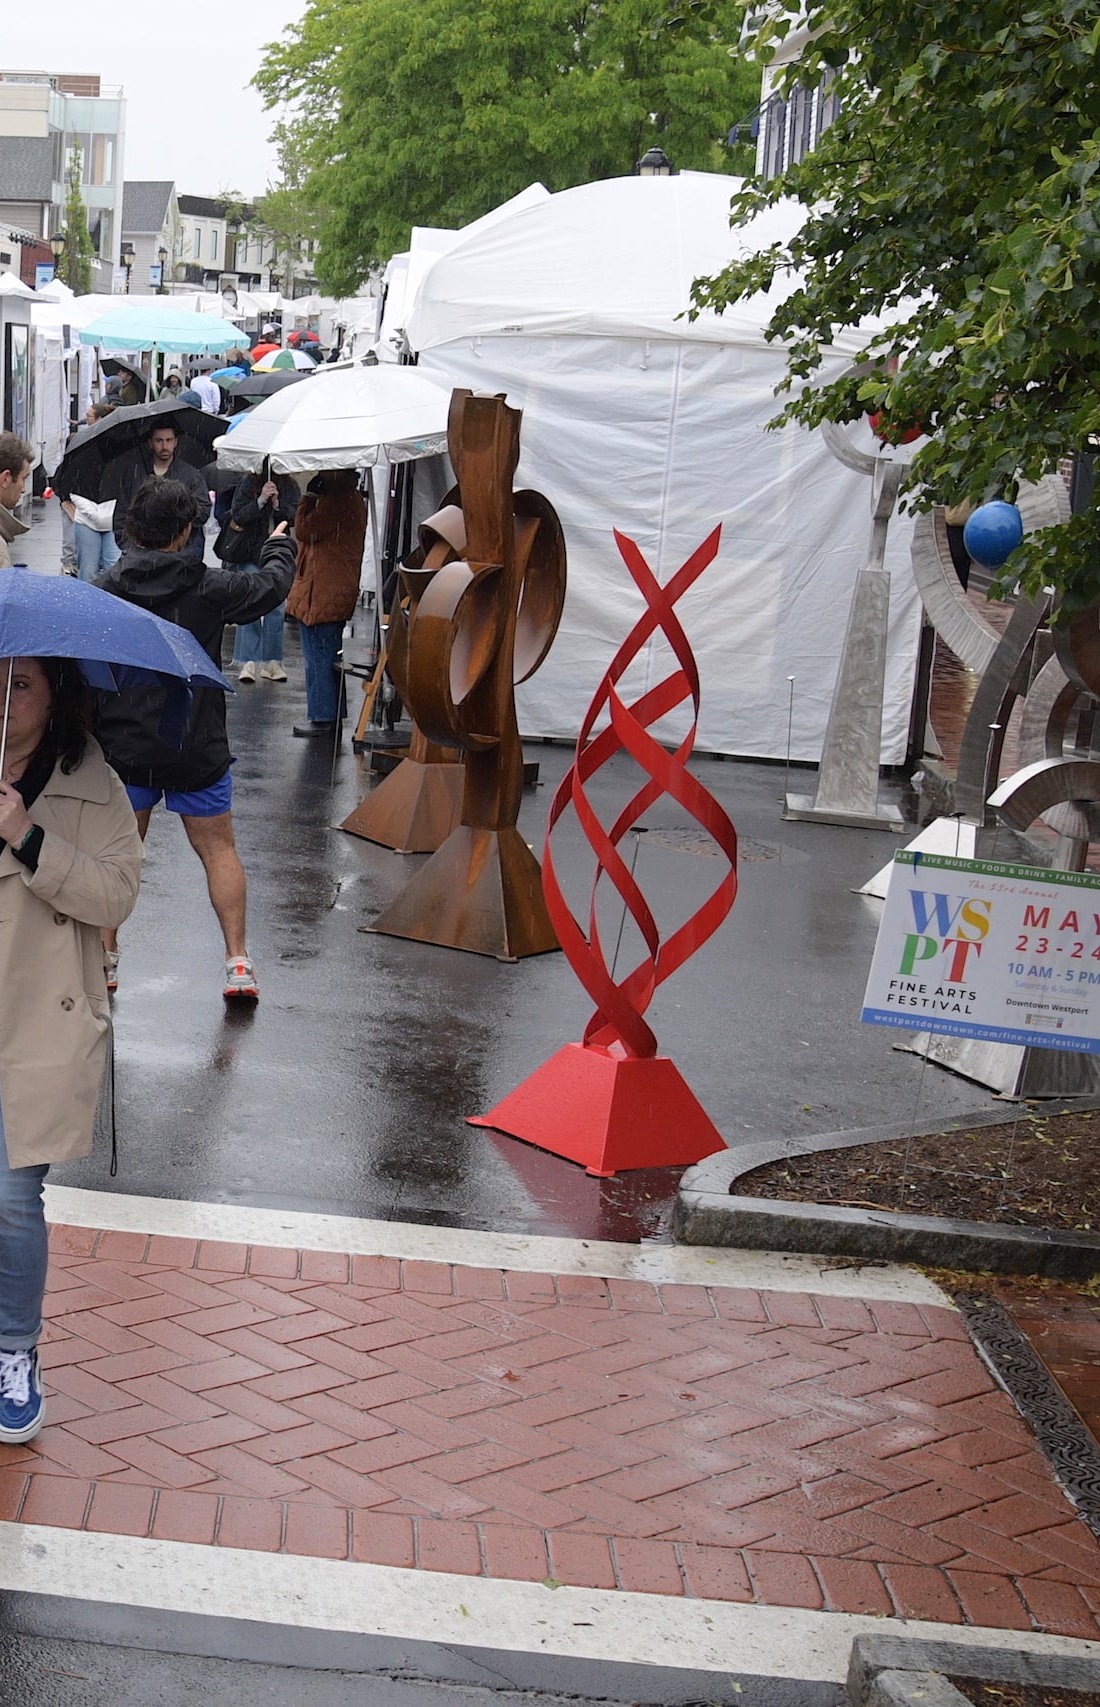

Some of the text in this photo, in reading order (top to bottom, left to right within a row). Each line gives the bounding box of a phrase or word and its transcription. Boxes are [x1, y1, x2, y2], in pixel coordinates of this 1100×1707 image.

[896, 852, 913, 861] ART
[922, 856, 941, 865] LIVE
[945, 858, 972, 868] MUSIC
[981, 863, 1006, 872] FOOD
[1018, 869, 1046, 878] DRINK
[1055, 873, 1088, 884] FAMILY
[1007, 962, 1024, 975] 10
[1027, 965, 1053, 979] AM
[1065, 969, 1074, 981] 5
[1078, 971, 1100, 985] PM
[890, 980, 977, 1001] FINE ARTS
[886, 993, 972, 1015] FESTIVAL
[1006, 998, 1089, 1016] Downtown Westport
[873, 1013, 1091, 1050] westportdowntown.com/fine-arts-festival
